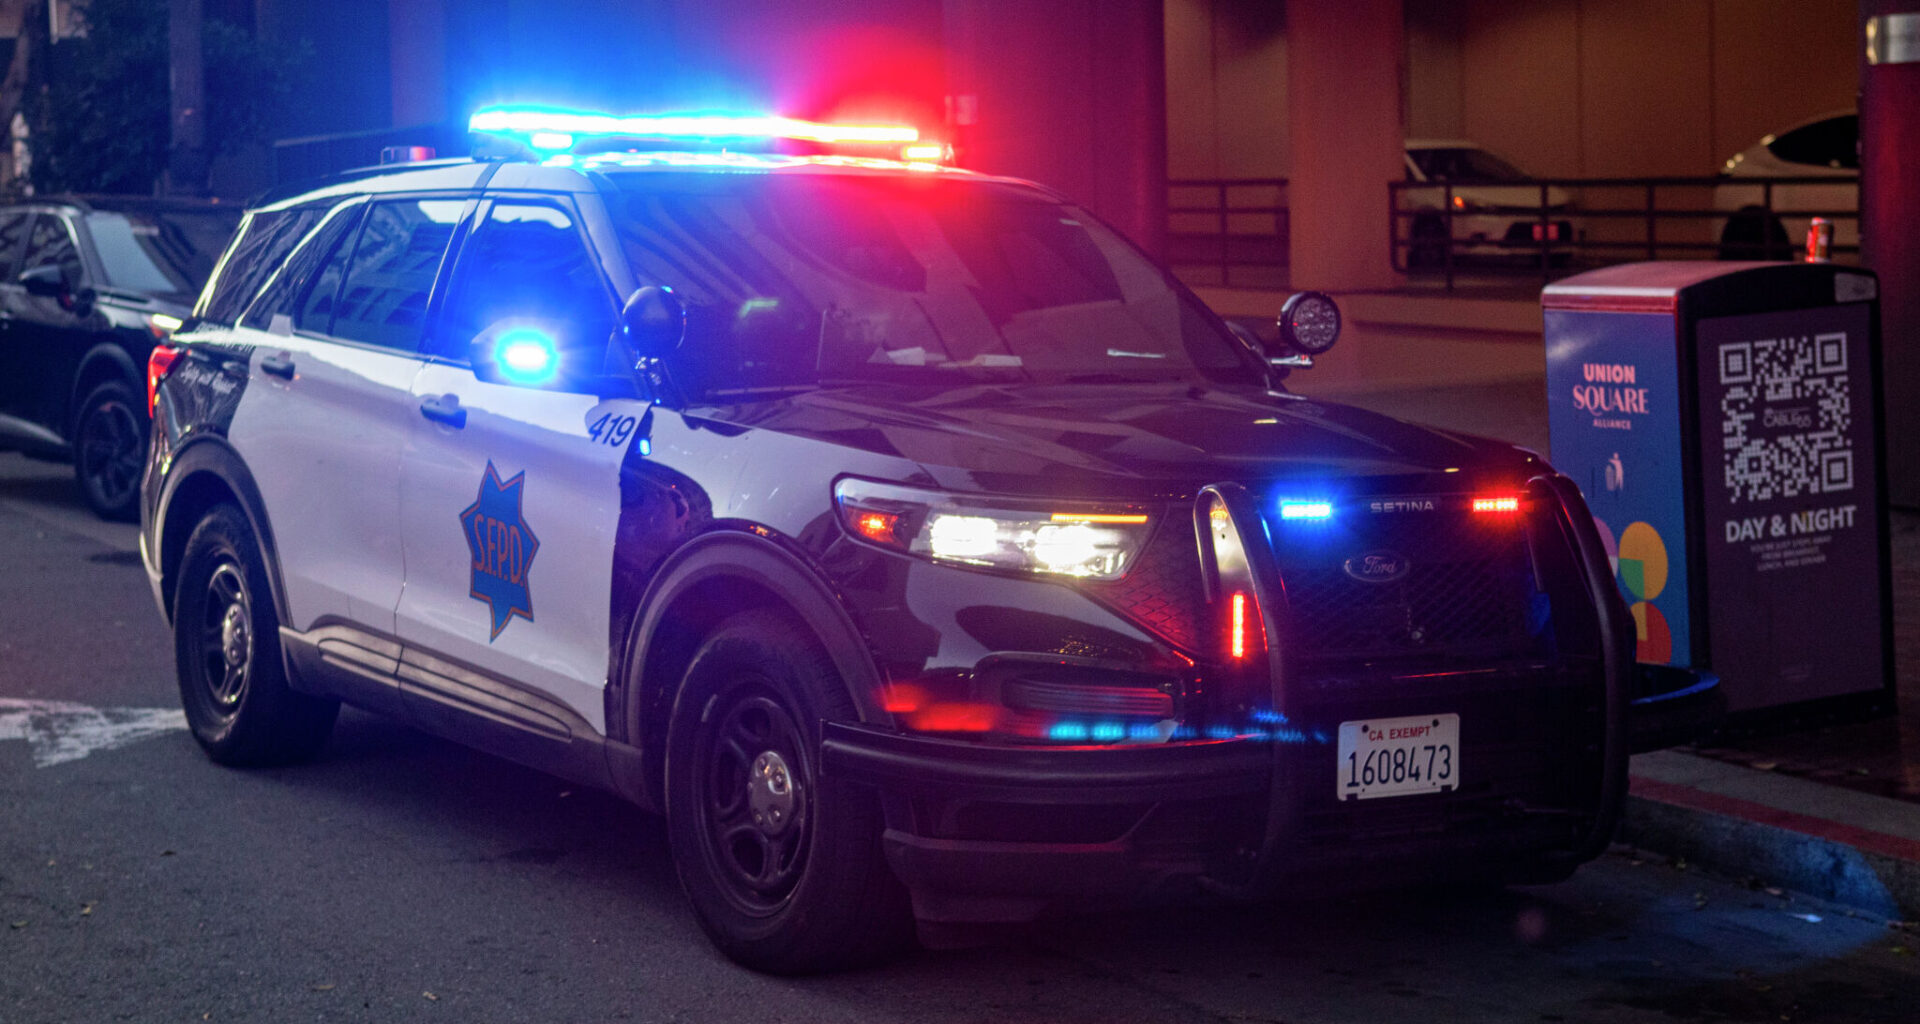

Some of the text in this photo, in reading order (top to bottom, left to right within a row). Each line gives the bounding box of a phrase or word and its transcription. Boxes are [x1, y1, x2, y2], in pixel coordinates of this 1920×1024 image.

[1583, 363, 1636, 384] UNION
[1572, 384, 1649, 416] SQUARE
[588, 412, 636, 447] 419
[1592, 418, 1631, 430] ALLIANCE
[1370, 501, 1434, 513] SETINA
[1725, 505, 1857, 543] DAY & NIGHT
[473, 513, 524, 587] S.F.P.D.
[1363, 555, 1397, 574] Ford
[1368, 726, 1432, 741] CA EXEMPT
[1346, 744, 1452, 788] 1608473
